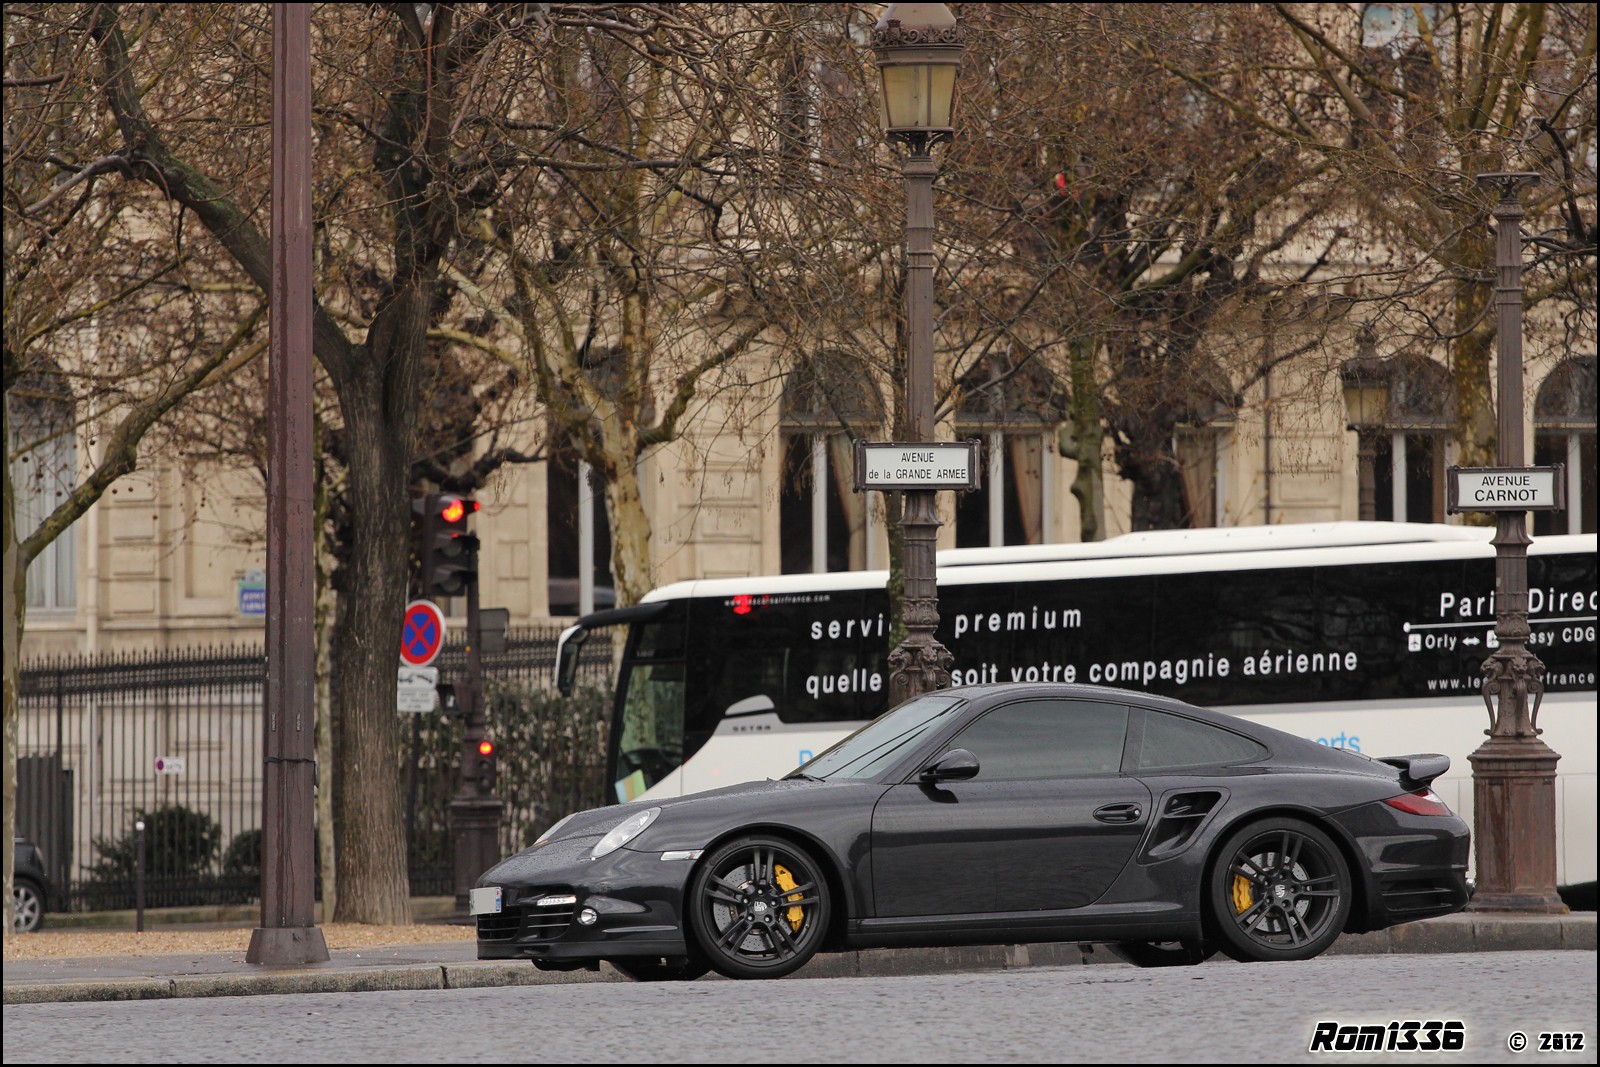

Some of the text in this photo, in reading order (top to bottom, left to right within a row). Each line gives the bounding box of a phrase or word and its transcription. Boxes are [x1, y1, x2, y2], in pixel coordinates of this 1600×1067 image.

[901, 452, 935, 463] AVENUE
[868, 469, 966, 479] de la GRANDE ARMEE
[1481, 476, 1530, 486] AVENUE
[1474, 489, 1539, 502] CARNOT
[1440, 590, 1496, 617] Pari
[954, 605, 1082, 639] premium
[1425, 633, 1458, 651] Orly
[1562, 626, 1596, 643] CDG
[805, 649, 1359, 700] quelle soit votre compagnie aérienne
